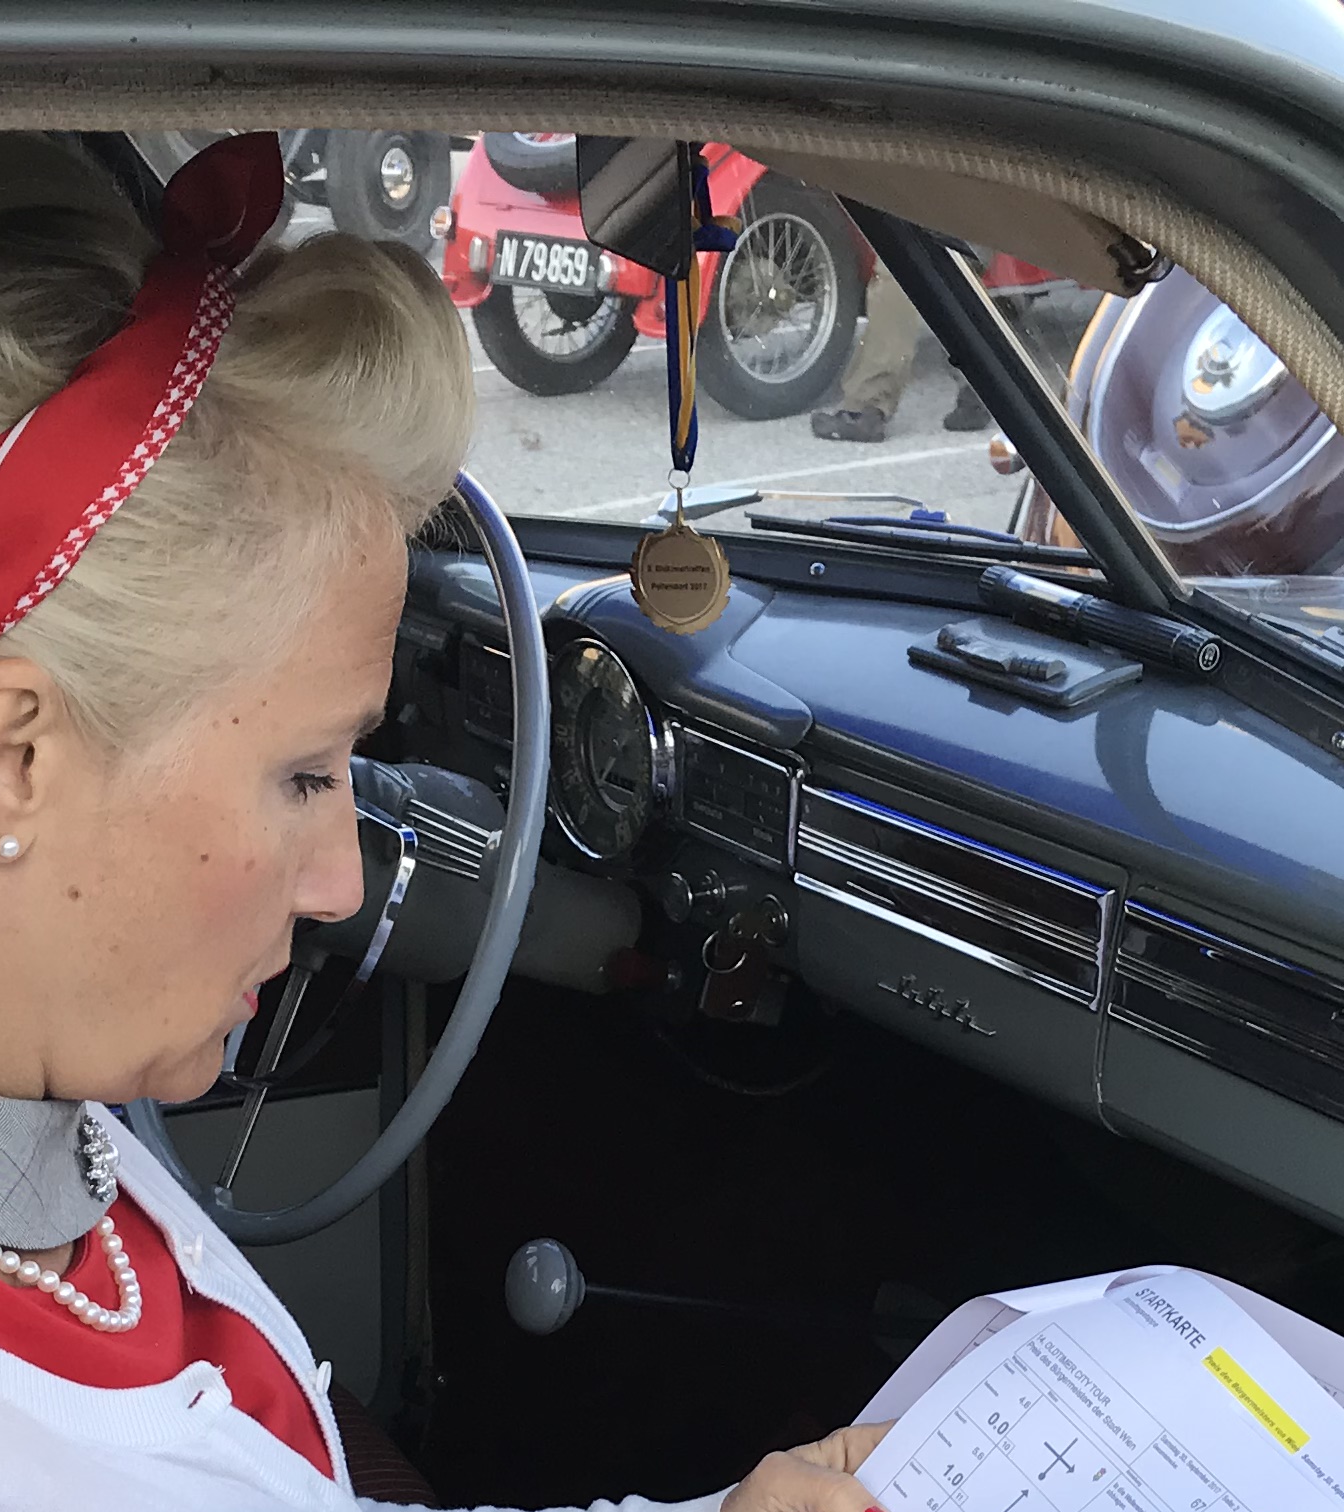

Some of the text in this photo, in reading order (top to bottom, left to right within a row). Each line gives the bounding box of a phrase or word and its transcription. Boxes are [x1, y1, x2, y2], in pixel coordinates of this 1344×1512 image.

[1134, 1285, 1206, 1349] STARTKARTE
[1043, 1339, 1077, 1374] OLDTIMER
[1073, 1369, 1092, 1389] CITY
[1088, 1384, 1111, 1407] TOUR
[1017, 1395, 1031, 1409] 4.6
[1026, 1340, 1138, 1451] Preis des Bürgermeisters der Stadt Wien
[985, 1410, 1010, 1436] 0.0
[1205, 1354, 1222, 1372] Preis
[1219, 1369, 1233, 1383] des
[1230, 1381, 1276, 1428] Bürgermeisters
[1273, 1426, 1286, 1439] von
[1284, 1436, 1301, 1453] Wien
[1300, 1452, 1325, 1479] Samstag
[971, 1446, 985, 1460] 5.6
[1000, 1440, 1011, 1450] 10
[1159, 1434, 1181, 1456] Samstag
[1185, 1459, 1210, 1485] September
[940, 1462, 965, 1487] 1.0
[925, 1497, 939, 1511] 5.6
[1189, 1496, 1206, 1512] 67
